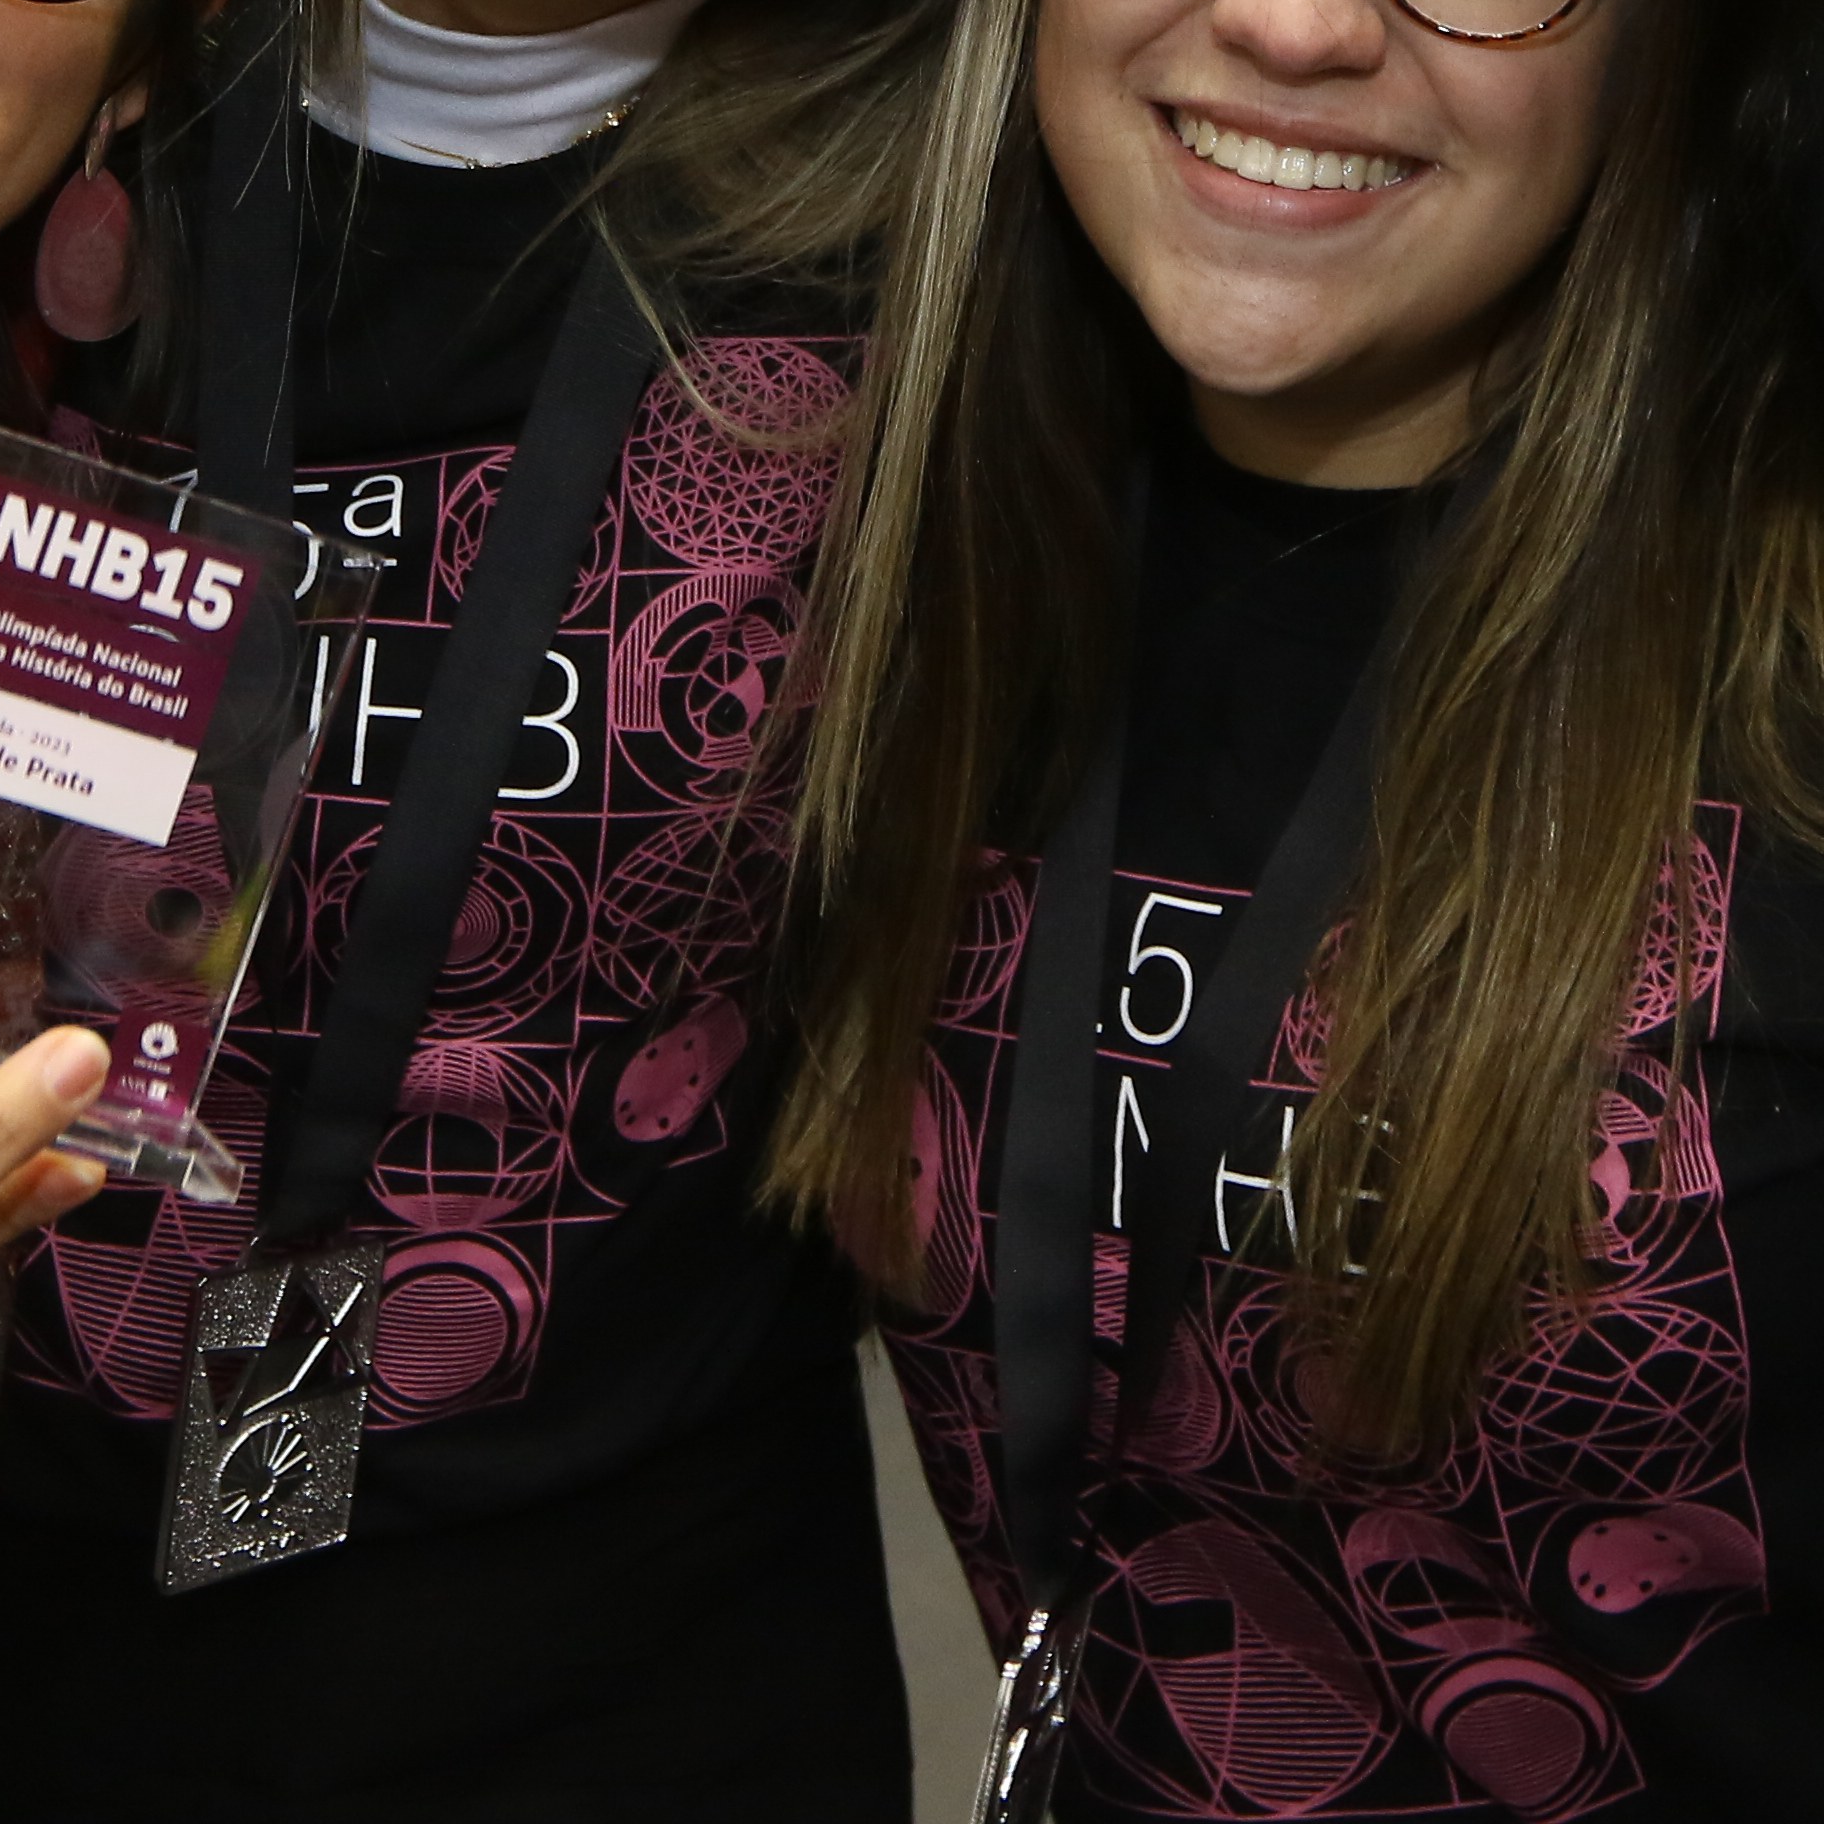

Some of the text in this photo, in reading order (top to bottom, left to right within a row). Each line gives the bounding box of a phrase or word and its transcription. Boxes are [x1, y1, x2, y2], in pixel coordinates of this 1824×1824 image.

[10, 642, 92, 690] História
[96, 672, 125, 700] do
[128, 681, 190, 720] Brasil
[92, 641, 183, 689] Nacional
[25, 755, 96, 797] Prata
